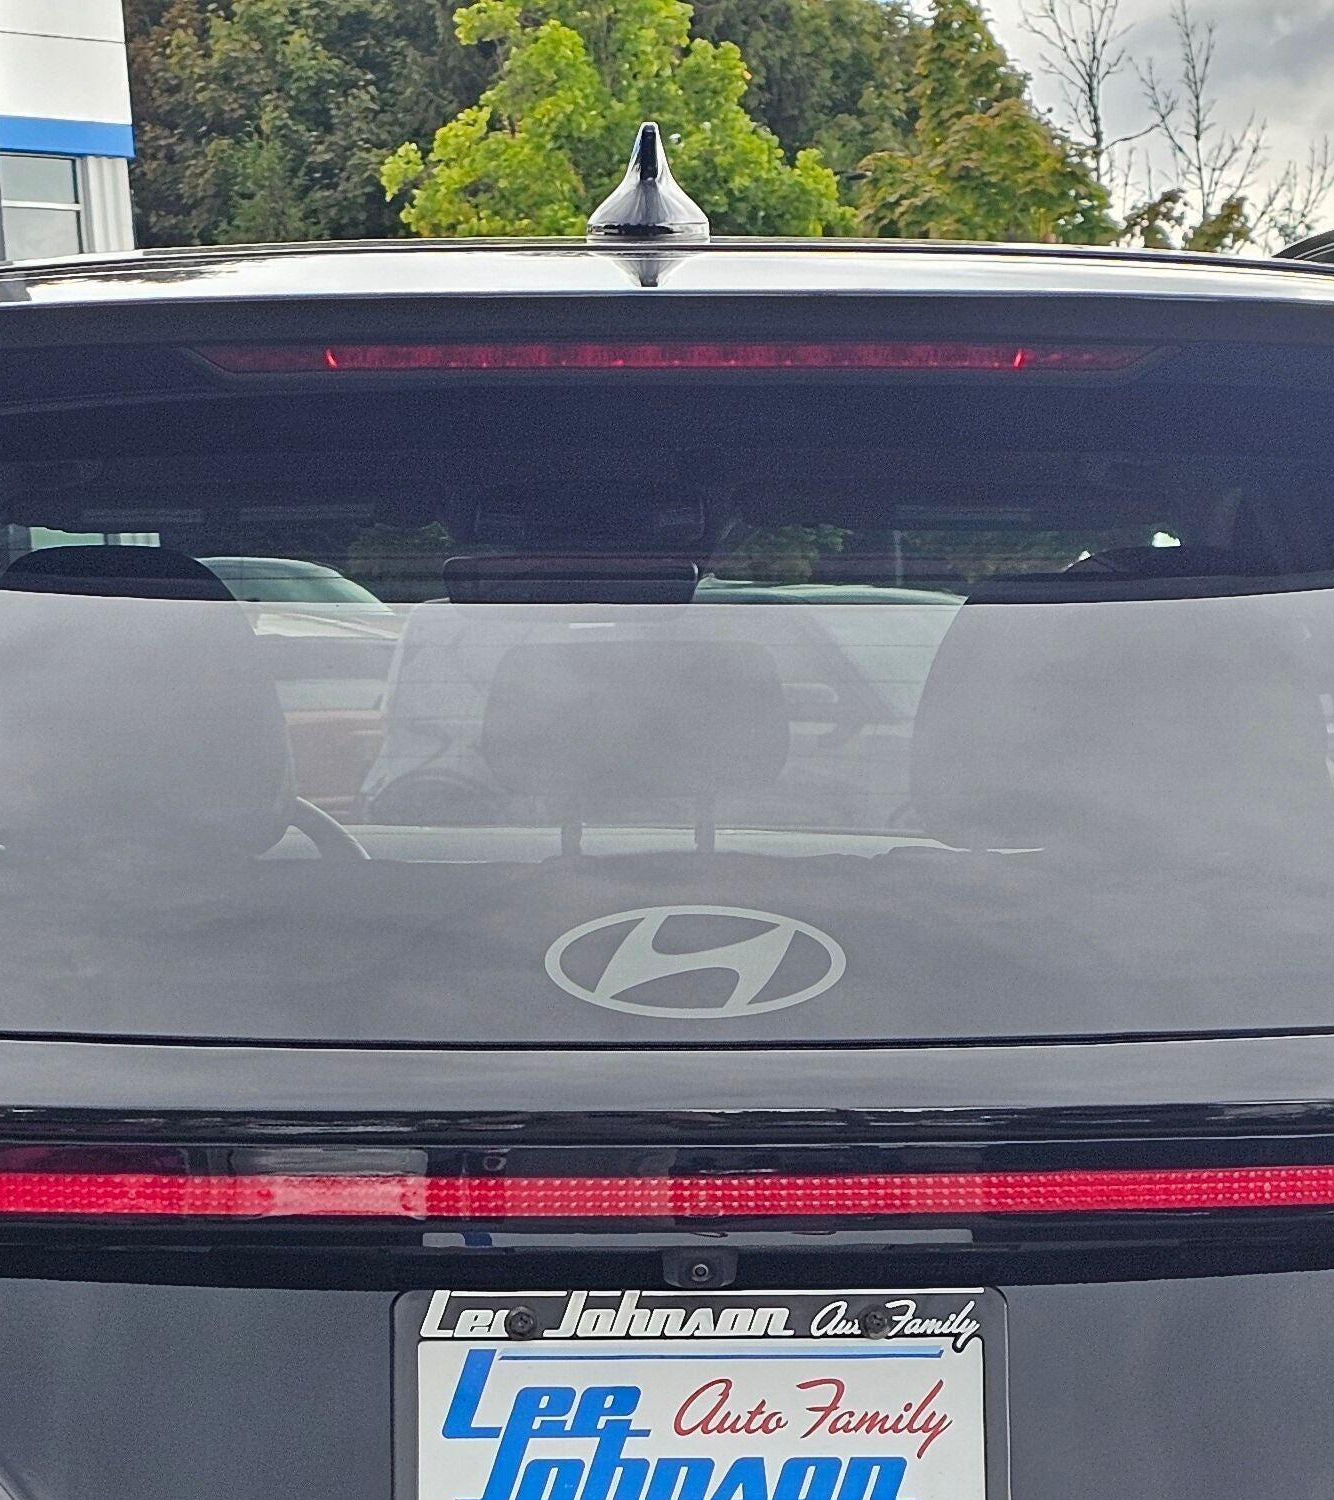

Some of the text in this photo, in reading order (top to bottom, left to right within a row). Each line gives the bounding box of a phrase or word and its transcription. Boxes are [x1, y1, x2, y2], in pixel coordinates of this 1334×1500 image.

[543, 1290, 794, 1337] Johnson
[811, 1300, 861, 1337] Au
[885, 1299, 980, 1348] Family
[442, 1349, 953, 1459] Lee Auto Family
